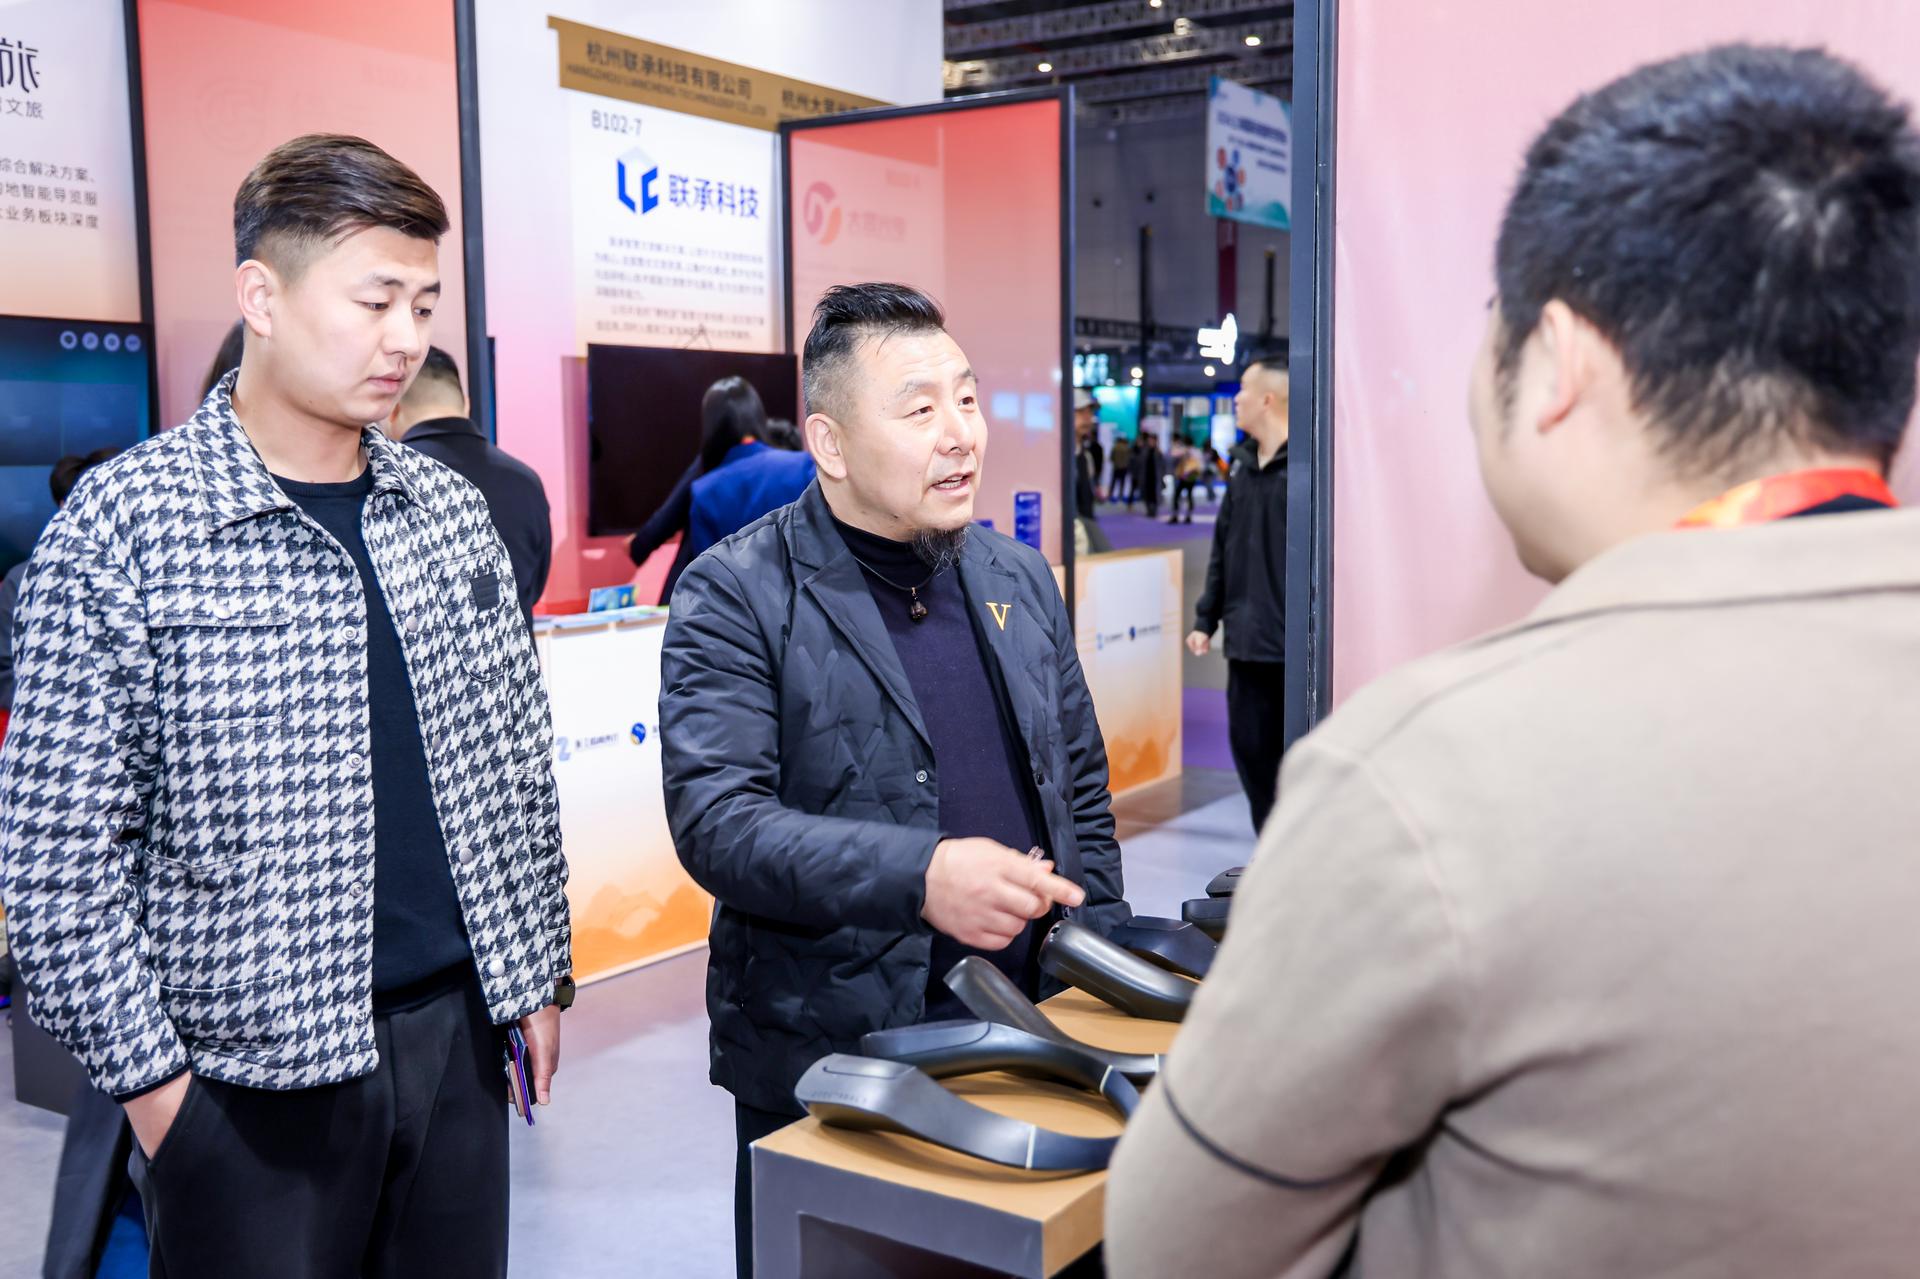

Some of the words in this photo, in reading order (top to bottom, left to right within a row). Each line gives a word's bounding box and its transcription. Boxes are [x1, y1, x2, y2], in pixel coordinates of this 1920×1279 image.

[586, 40, 752, 101] 杭州联承科技有限公司
[0, 97, 43, 119] 文旅
[591, 109, 642, 135] B102-7
[0, 182, 97, 206] 地智能导览服
[668, 173, 759, 219] 联承科技
[0, 205, 98, 229] 业务板块深度
